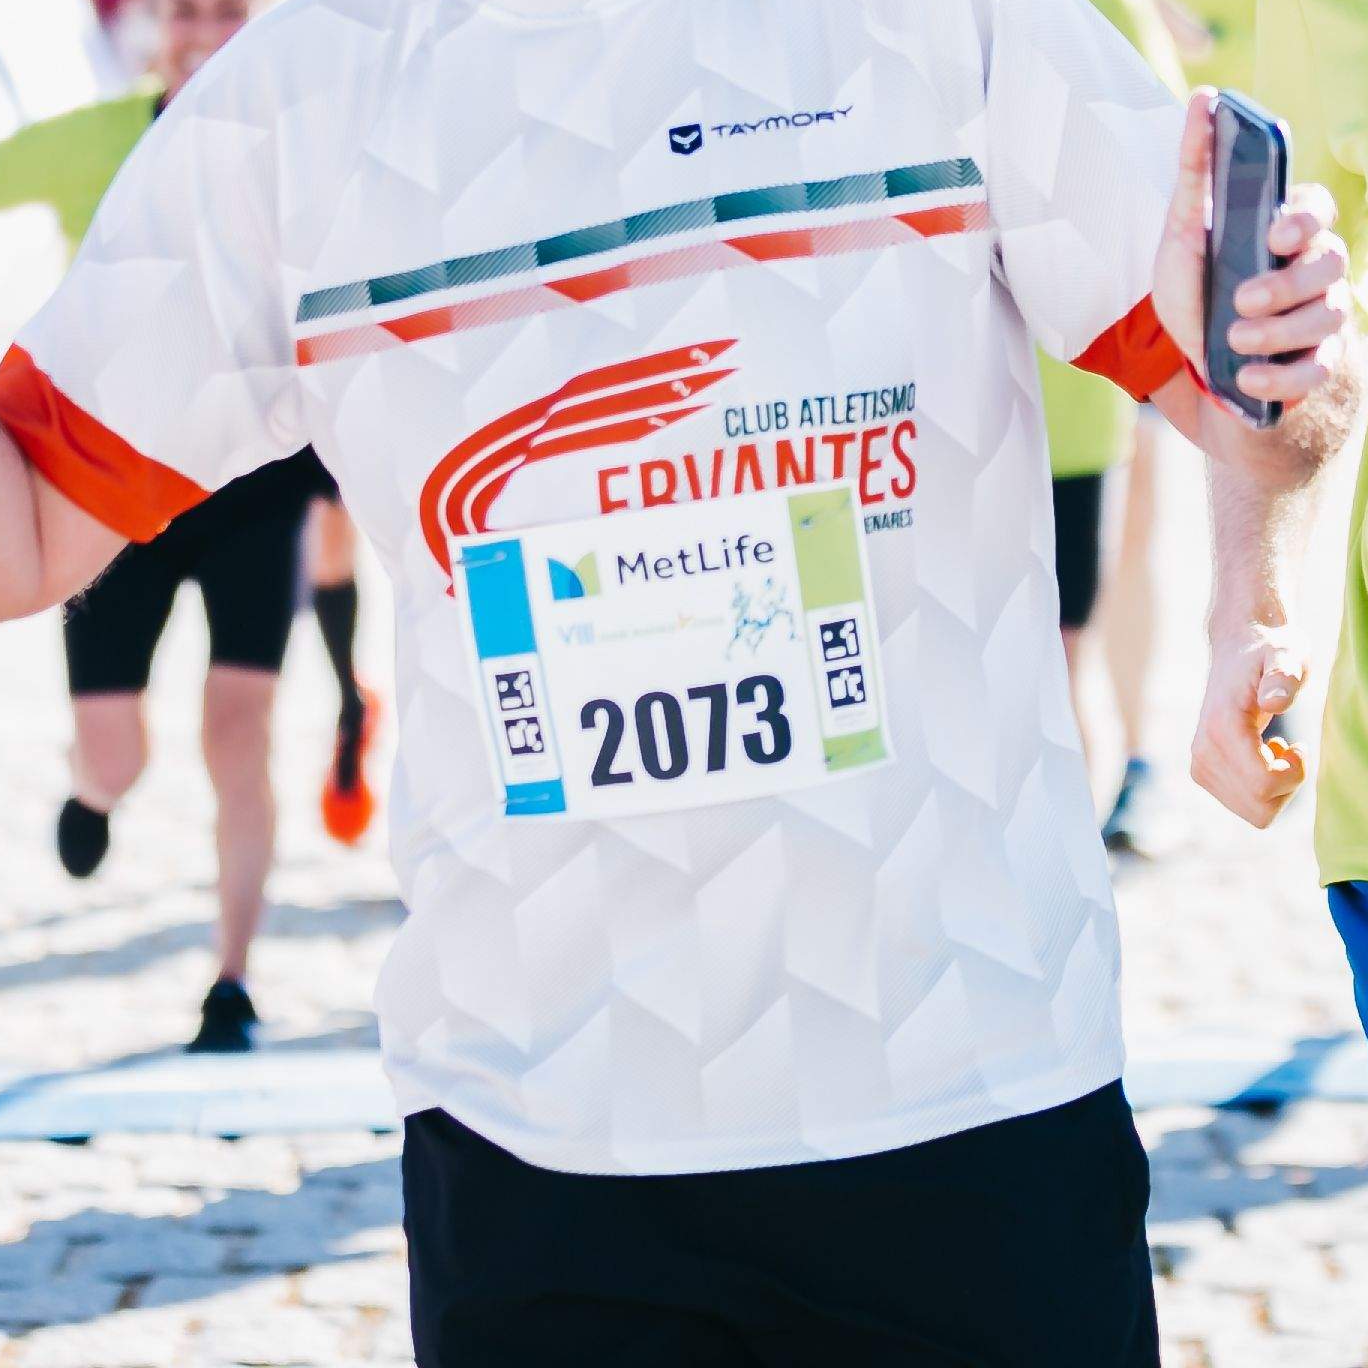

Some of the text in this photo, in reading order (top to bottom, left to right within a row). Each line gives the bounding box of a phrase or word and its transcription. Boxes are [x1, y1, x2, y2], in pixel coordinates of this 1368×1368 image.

[725, 382, 916, 439] CLUB ATLETISMO
[617, 535, 775, 585] MetLife
[580, 674, 793, 787] 2073
